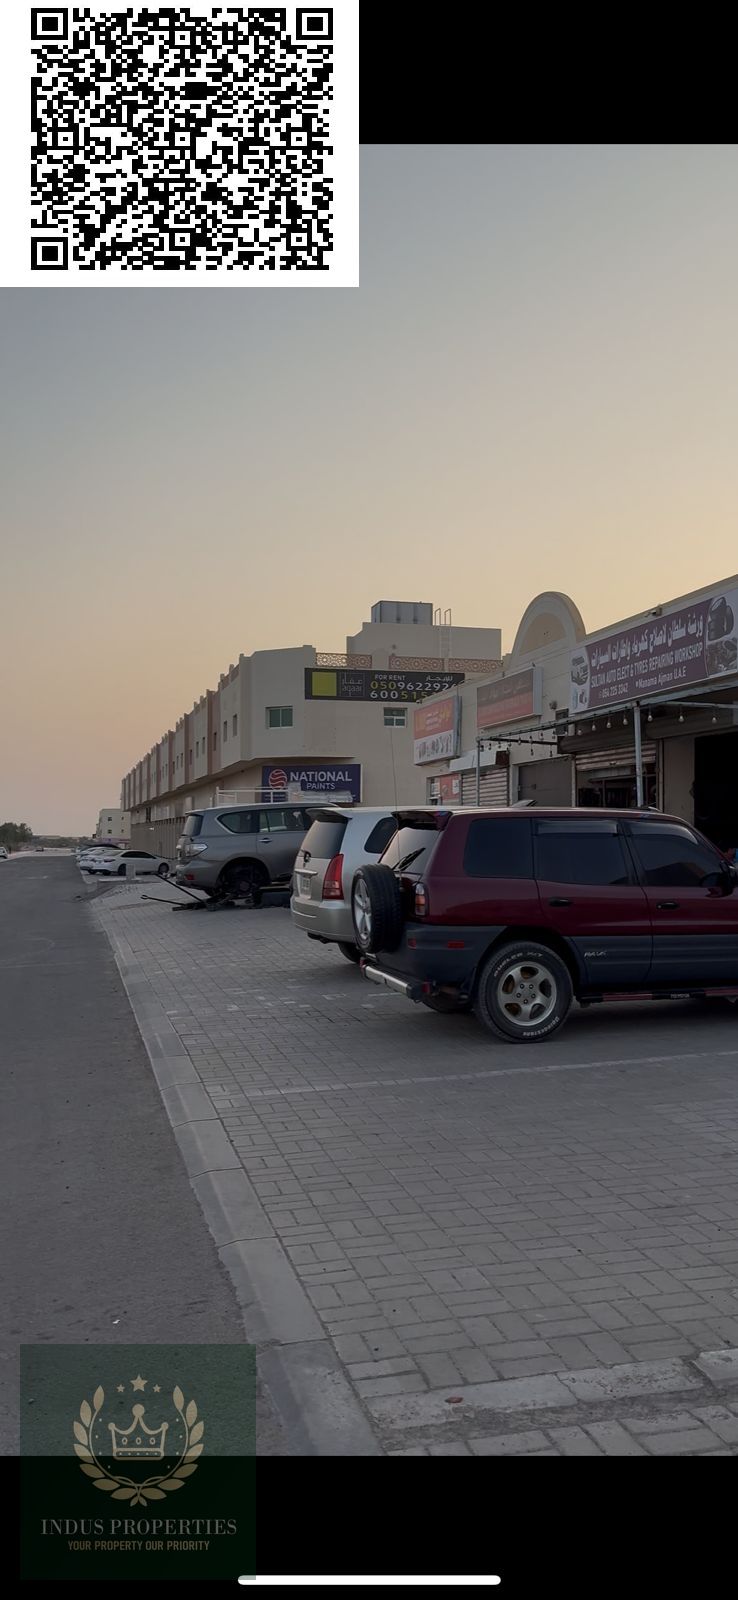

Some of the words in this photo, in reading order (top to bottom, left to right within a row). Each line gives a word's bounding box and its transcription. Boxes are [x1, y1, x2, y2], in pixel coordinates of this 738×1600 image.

[591, 672, 606, 689] SULTAN
[606, 669, 617, 685] AUTO
[617, 665, 630, 681] ELECT
[630, 664, 634, 678] &
[634, 659, 649, 676] TYRES
[648, 651, 674, 672] REPAIRING
[674, 642, 703, 664] WORKSHOP
[639, 676, 657, 689] Manama
[658, 672, 673, 686] Ajman
[370, 690, 435, 700] 600515
[290, 770, 352, 782] NATIONAL
